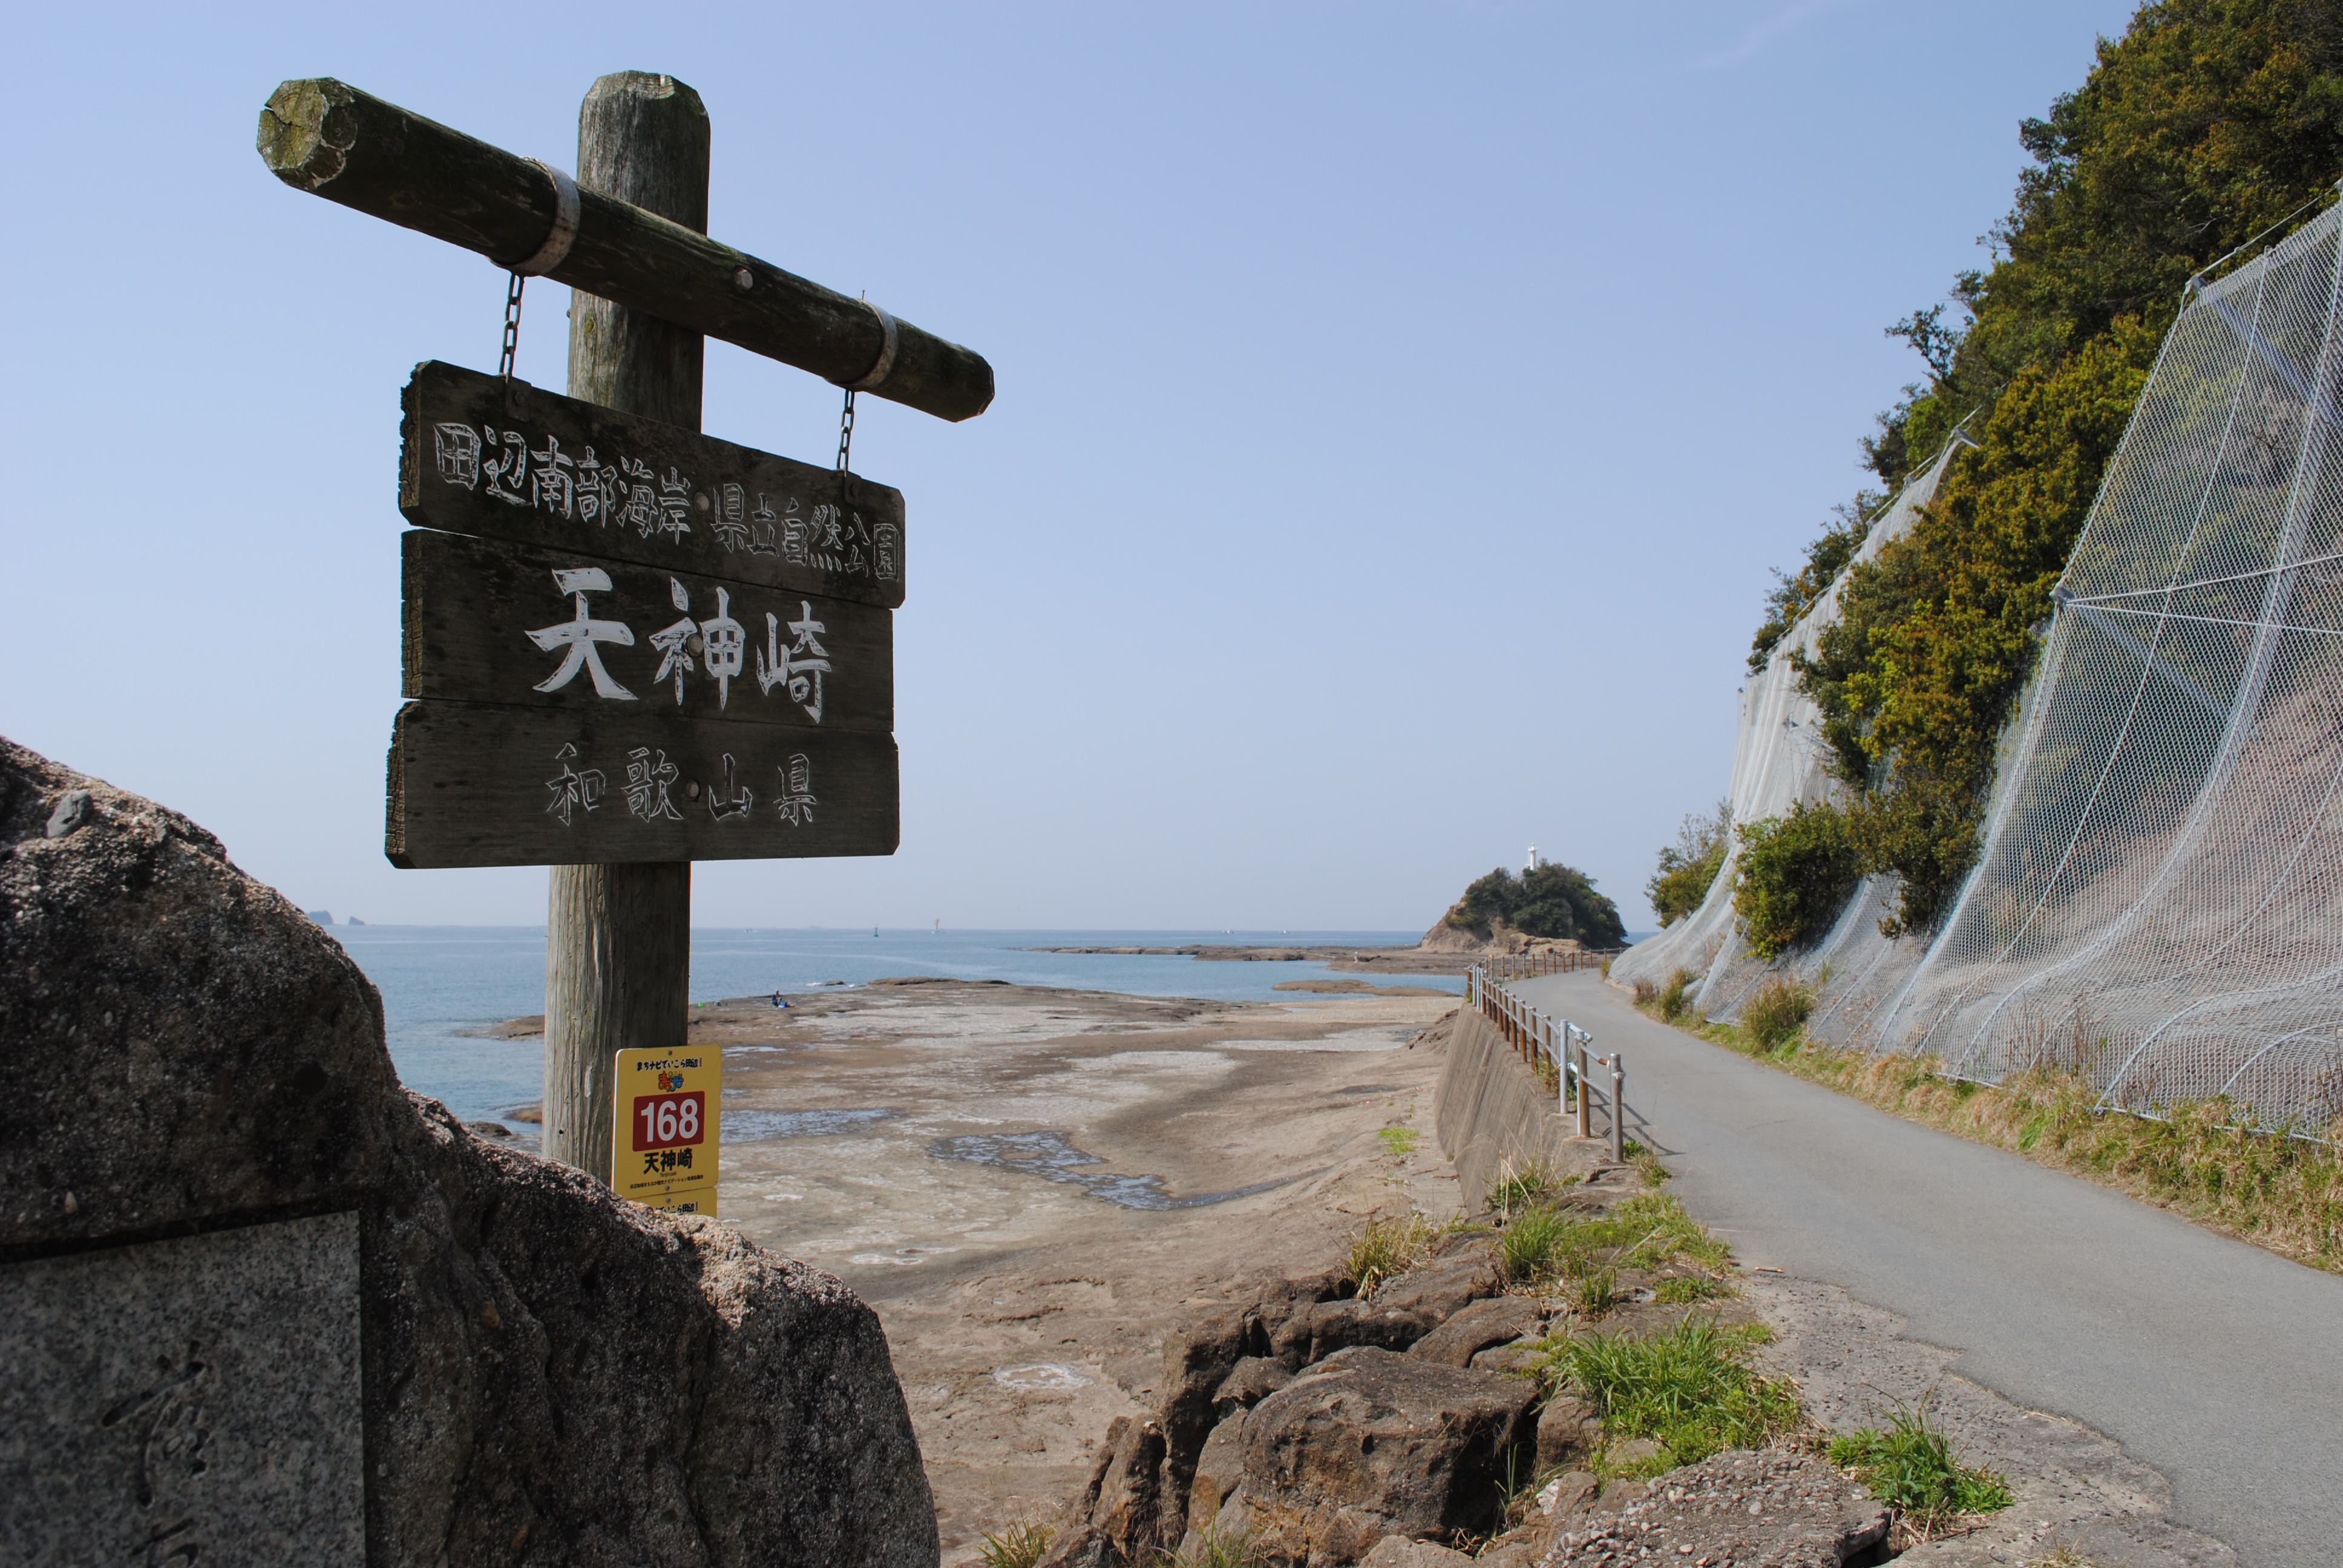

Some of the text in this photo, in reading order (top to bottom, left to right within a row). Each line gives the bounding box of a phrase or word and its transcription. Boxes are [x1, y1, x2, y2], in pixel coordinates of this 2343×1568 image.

[525, 567, 831, 724] 天神崎
[545, 743, 817, 826] 和歌山県
[640, 1098, 699, 1143] 168
[643, 1148, 693, 1175] 天神崎
